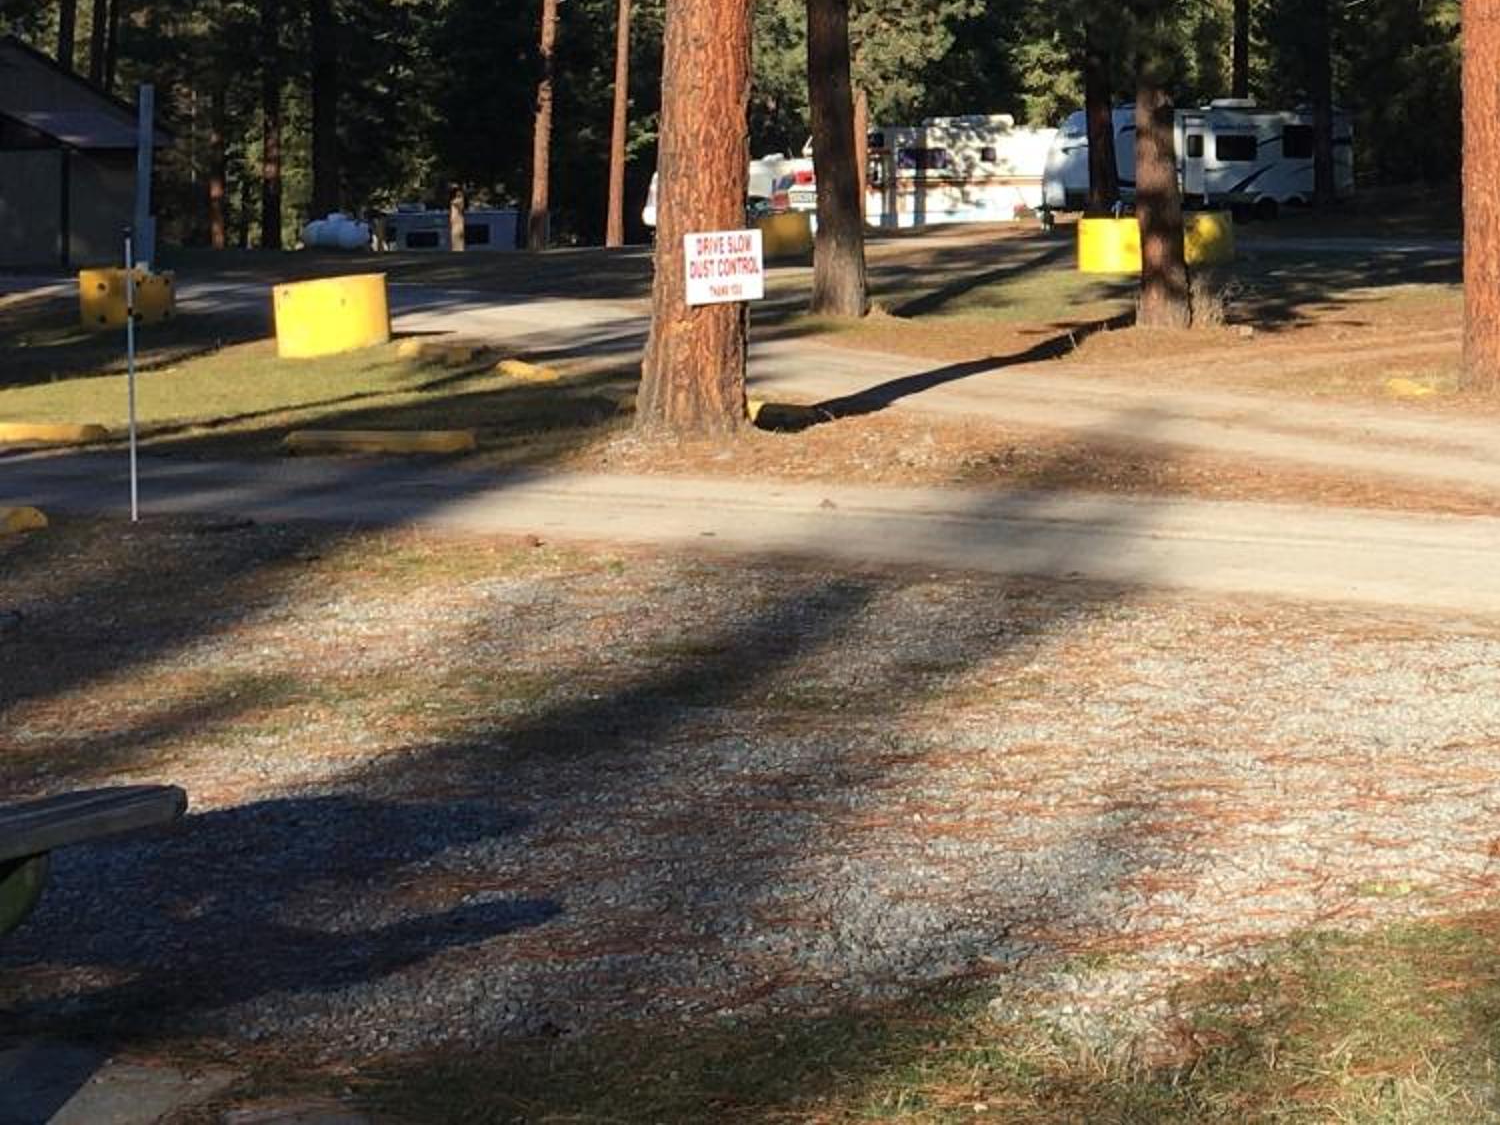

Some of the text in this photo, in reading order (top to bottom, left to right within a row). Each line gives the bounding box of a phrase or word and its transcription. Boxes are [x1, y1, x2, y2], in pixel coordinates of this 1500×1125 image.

[696, 234, 752, 256] DRIVE SLOW
[689, 256, 760, 279] DUST CONTROL
